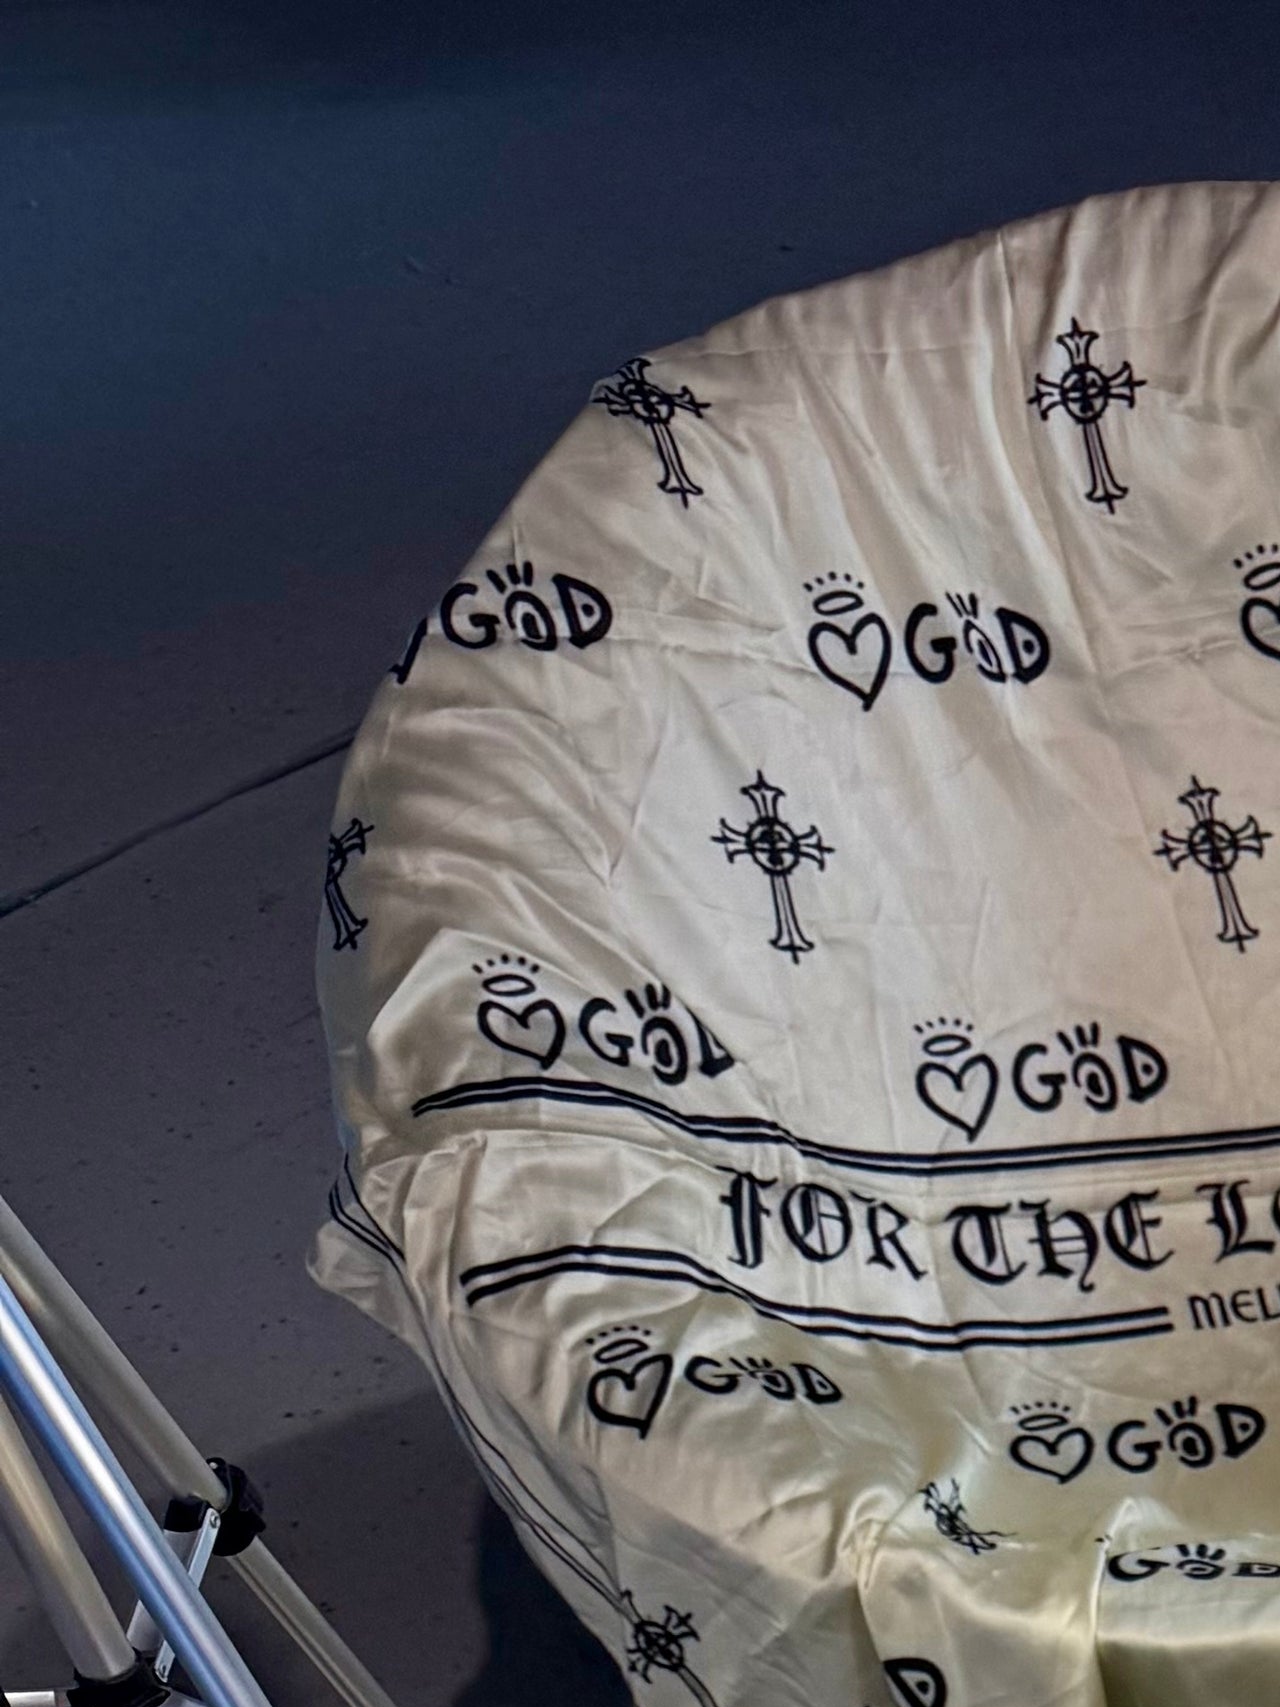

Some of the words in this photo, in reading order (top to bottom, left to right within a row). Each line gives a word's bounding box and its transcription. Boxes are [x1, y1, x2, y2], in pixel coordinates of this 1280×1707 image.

[439, 562, 612, 651] GOD
[903, 592, 1051, 684] GOD
[1012, 1022, 1169, 1114] GOD
[945, 1190, 1174, 1292] THE
[1107, 1397, 1268, 1474] GOD
